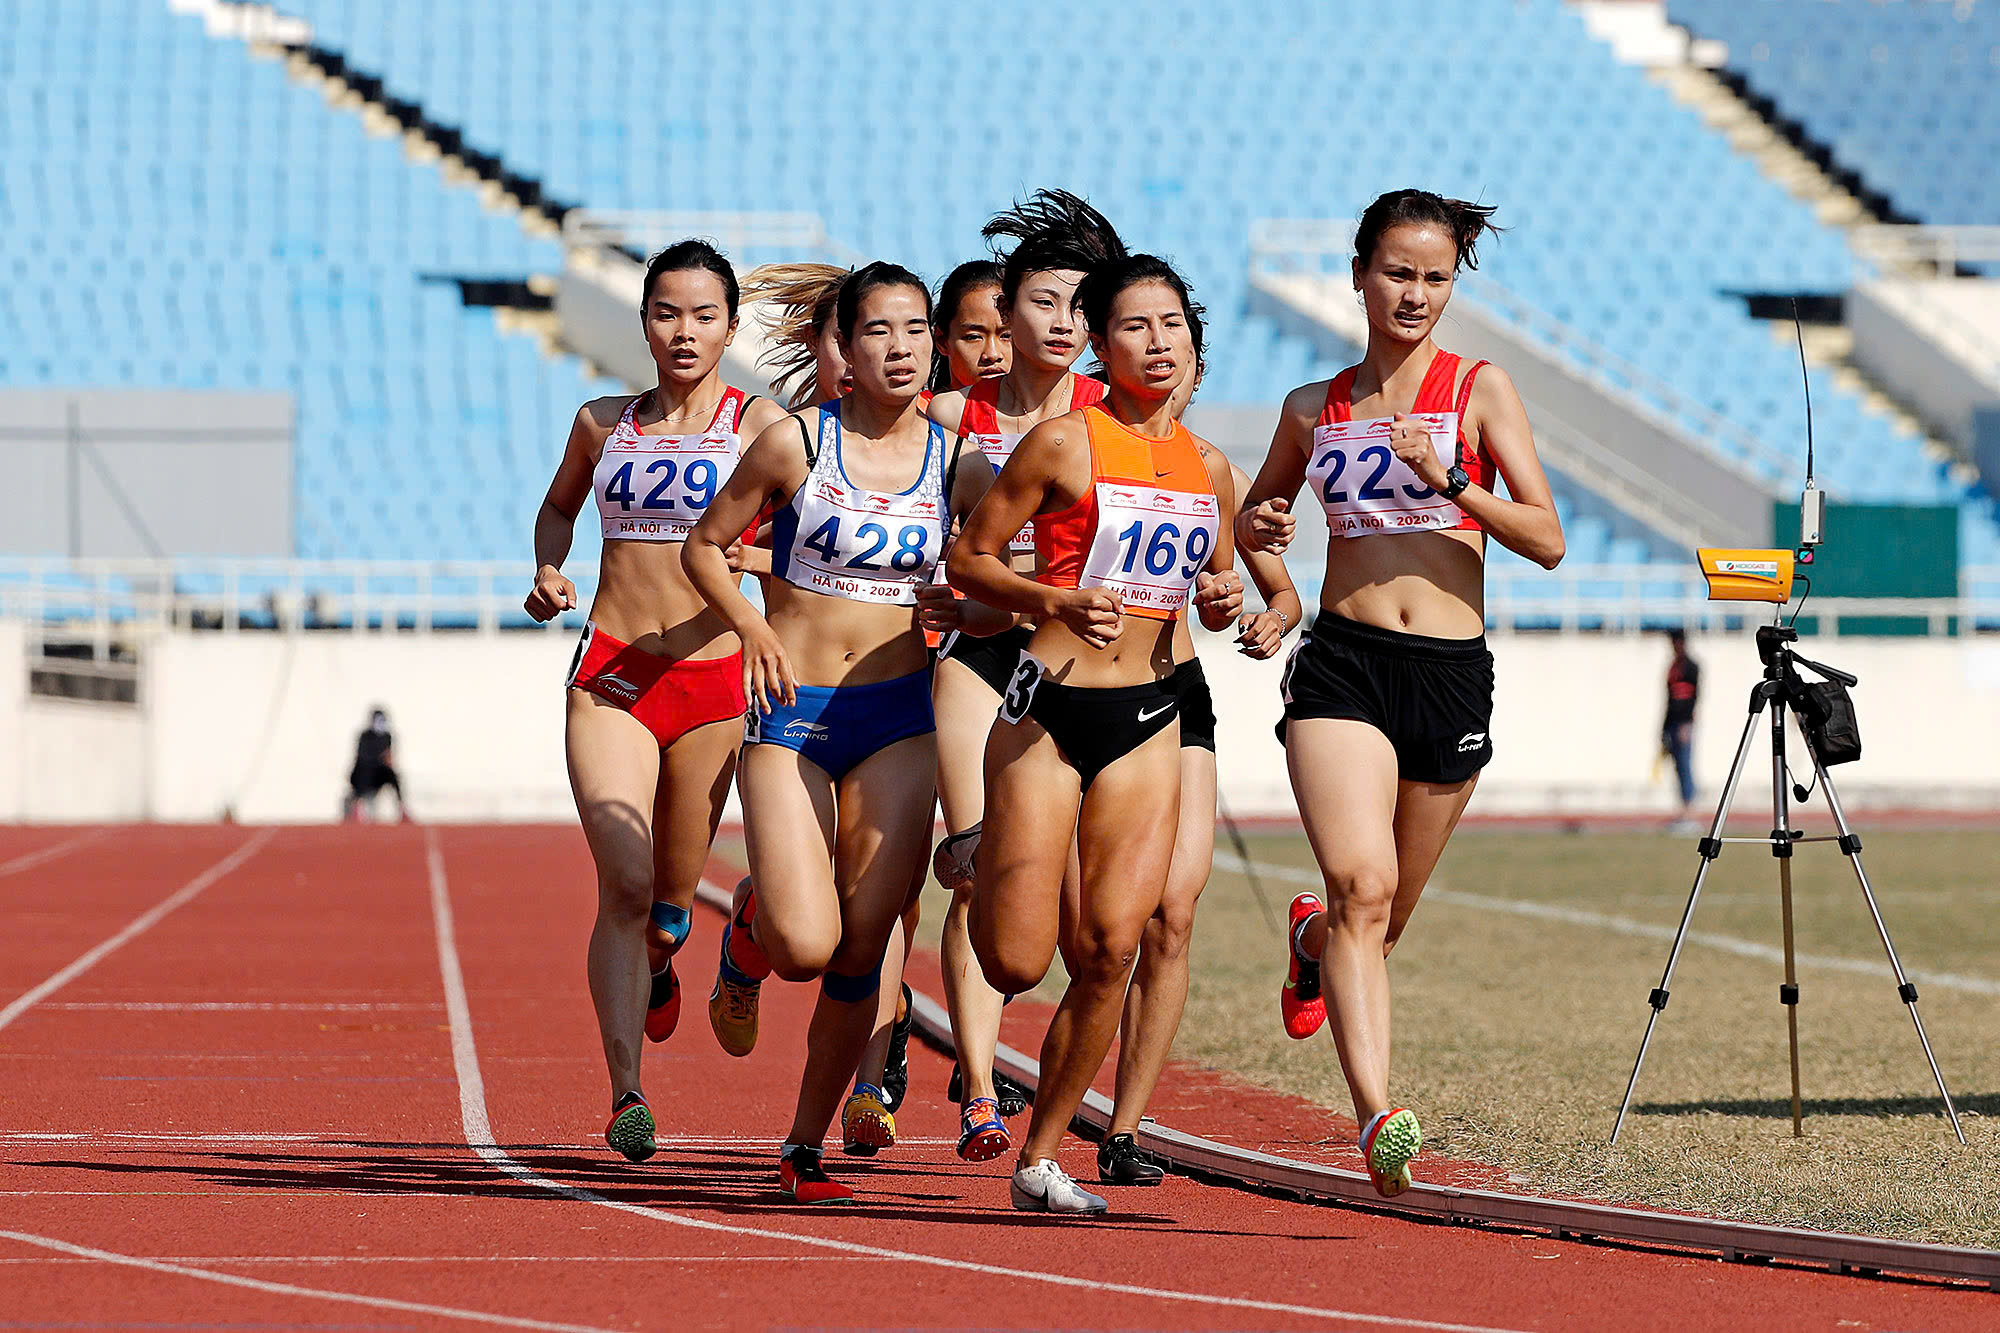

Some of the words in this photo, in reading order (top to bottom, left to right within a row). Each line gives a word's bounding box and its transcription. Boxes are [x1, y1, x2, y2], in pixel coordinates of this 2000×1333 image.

[1322, 432, 1348, 440] LI-NING
[604, 459, 718, 512] 429
[1152, 502, 1176, 510] LI-NING
[620, 521, 636, 533] HÀ
[638, 520, 661, 537] NỘI
[671, 525, 693, 534] 202
[1339, 518, 1358, 531] HÀ
[1360, 516, 1385, 531] NỘI
[1396, 514, 1430, 527] 2020
[803, 514, 928, 573] 428
[1118, 520, 1210, 580] 169
[812, 571, 831, 588] HÀ
[834, 580, 860, 596] NỘI
[869, 586, 901, 597] 2020
[1131, 588, 1151, 604] NỘI
[1160, 594, 1184, 605] 2020
[596, 680, 638, 701] LI-NING
[1006, 658, 1040, 719] 3
[783, 729, 829, 741] LI-NING
